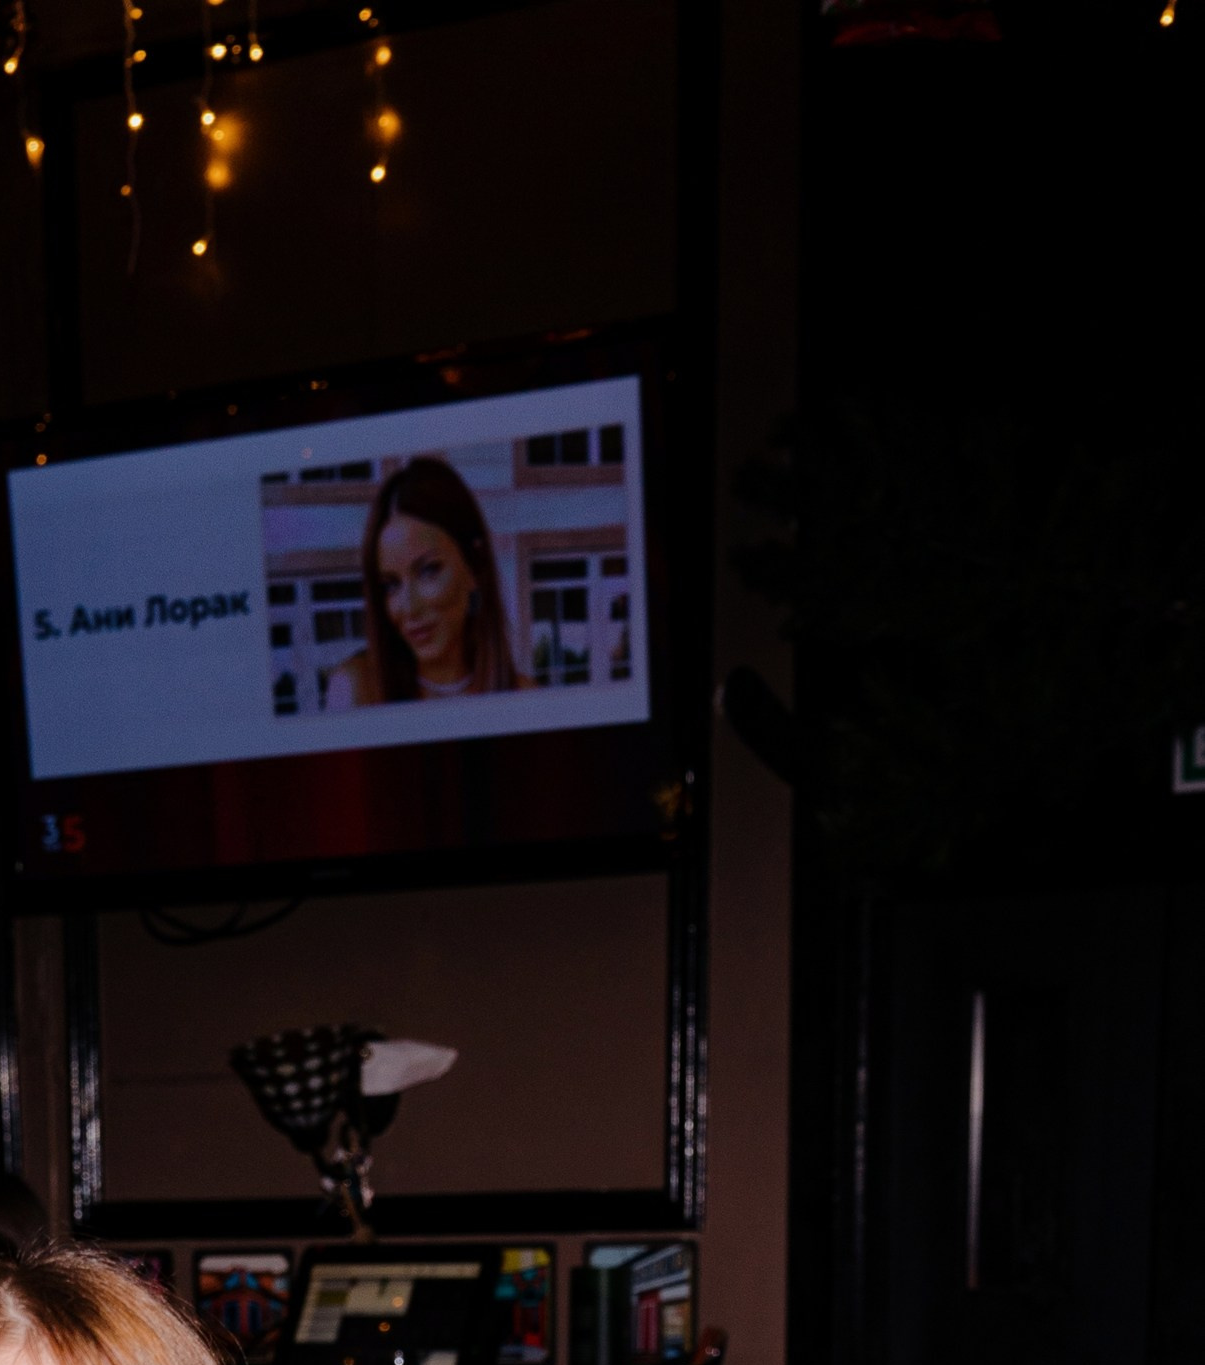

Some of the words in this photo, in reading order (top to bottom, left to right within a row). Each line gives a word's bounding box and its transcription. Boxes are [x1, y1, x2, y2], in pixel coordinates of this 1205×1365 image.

[34, 608, 62, 641] 5.
[68, 603, 136, 636] Ани
[144, 589, 251, 630] Лорак
